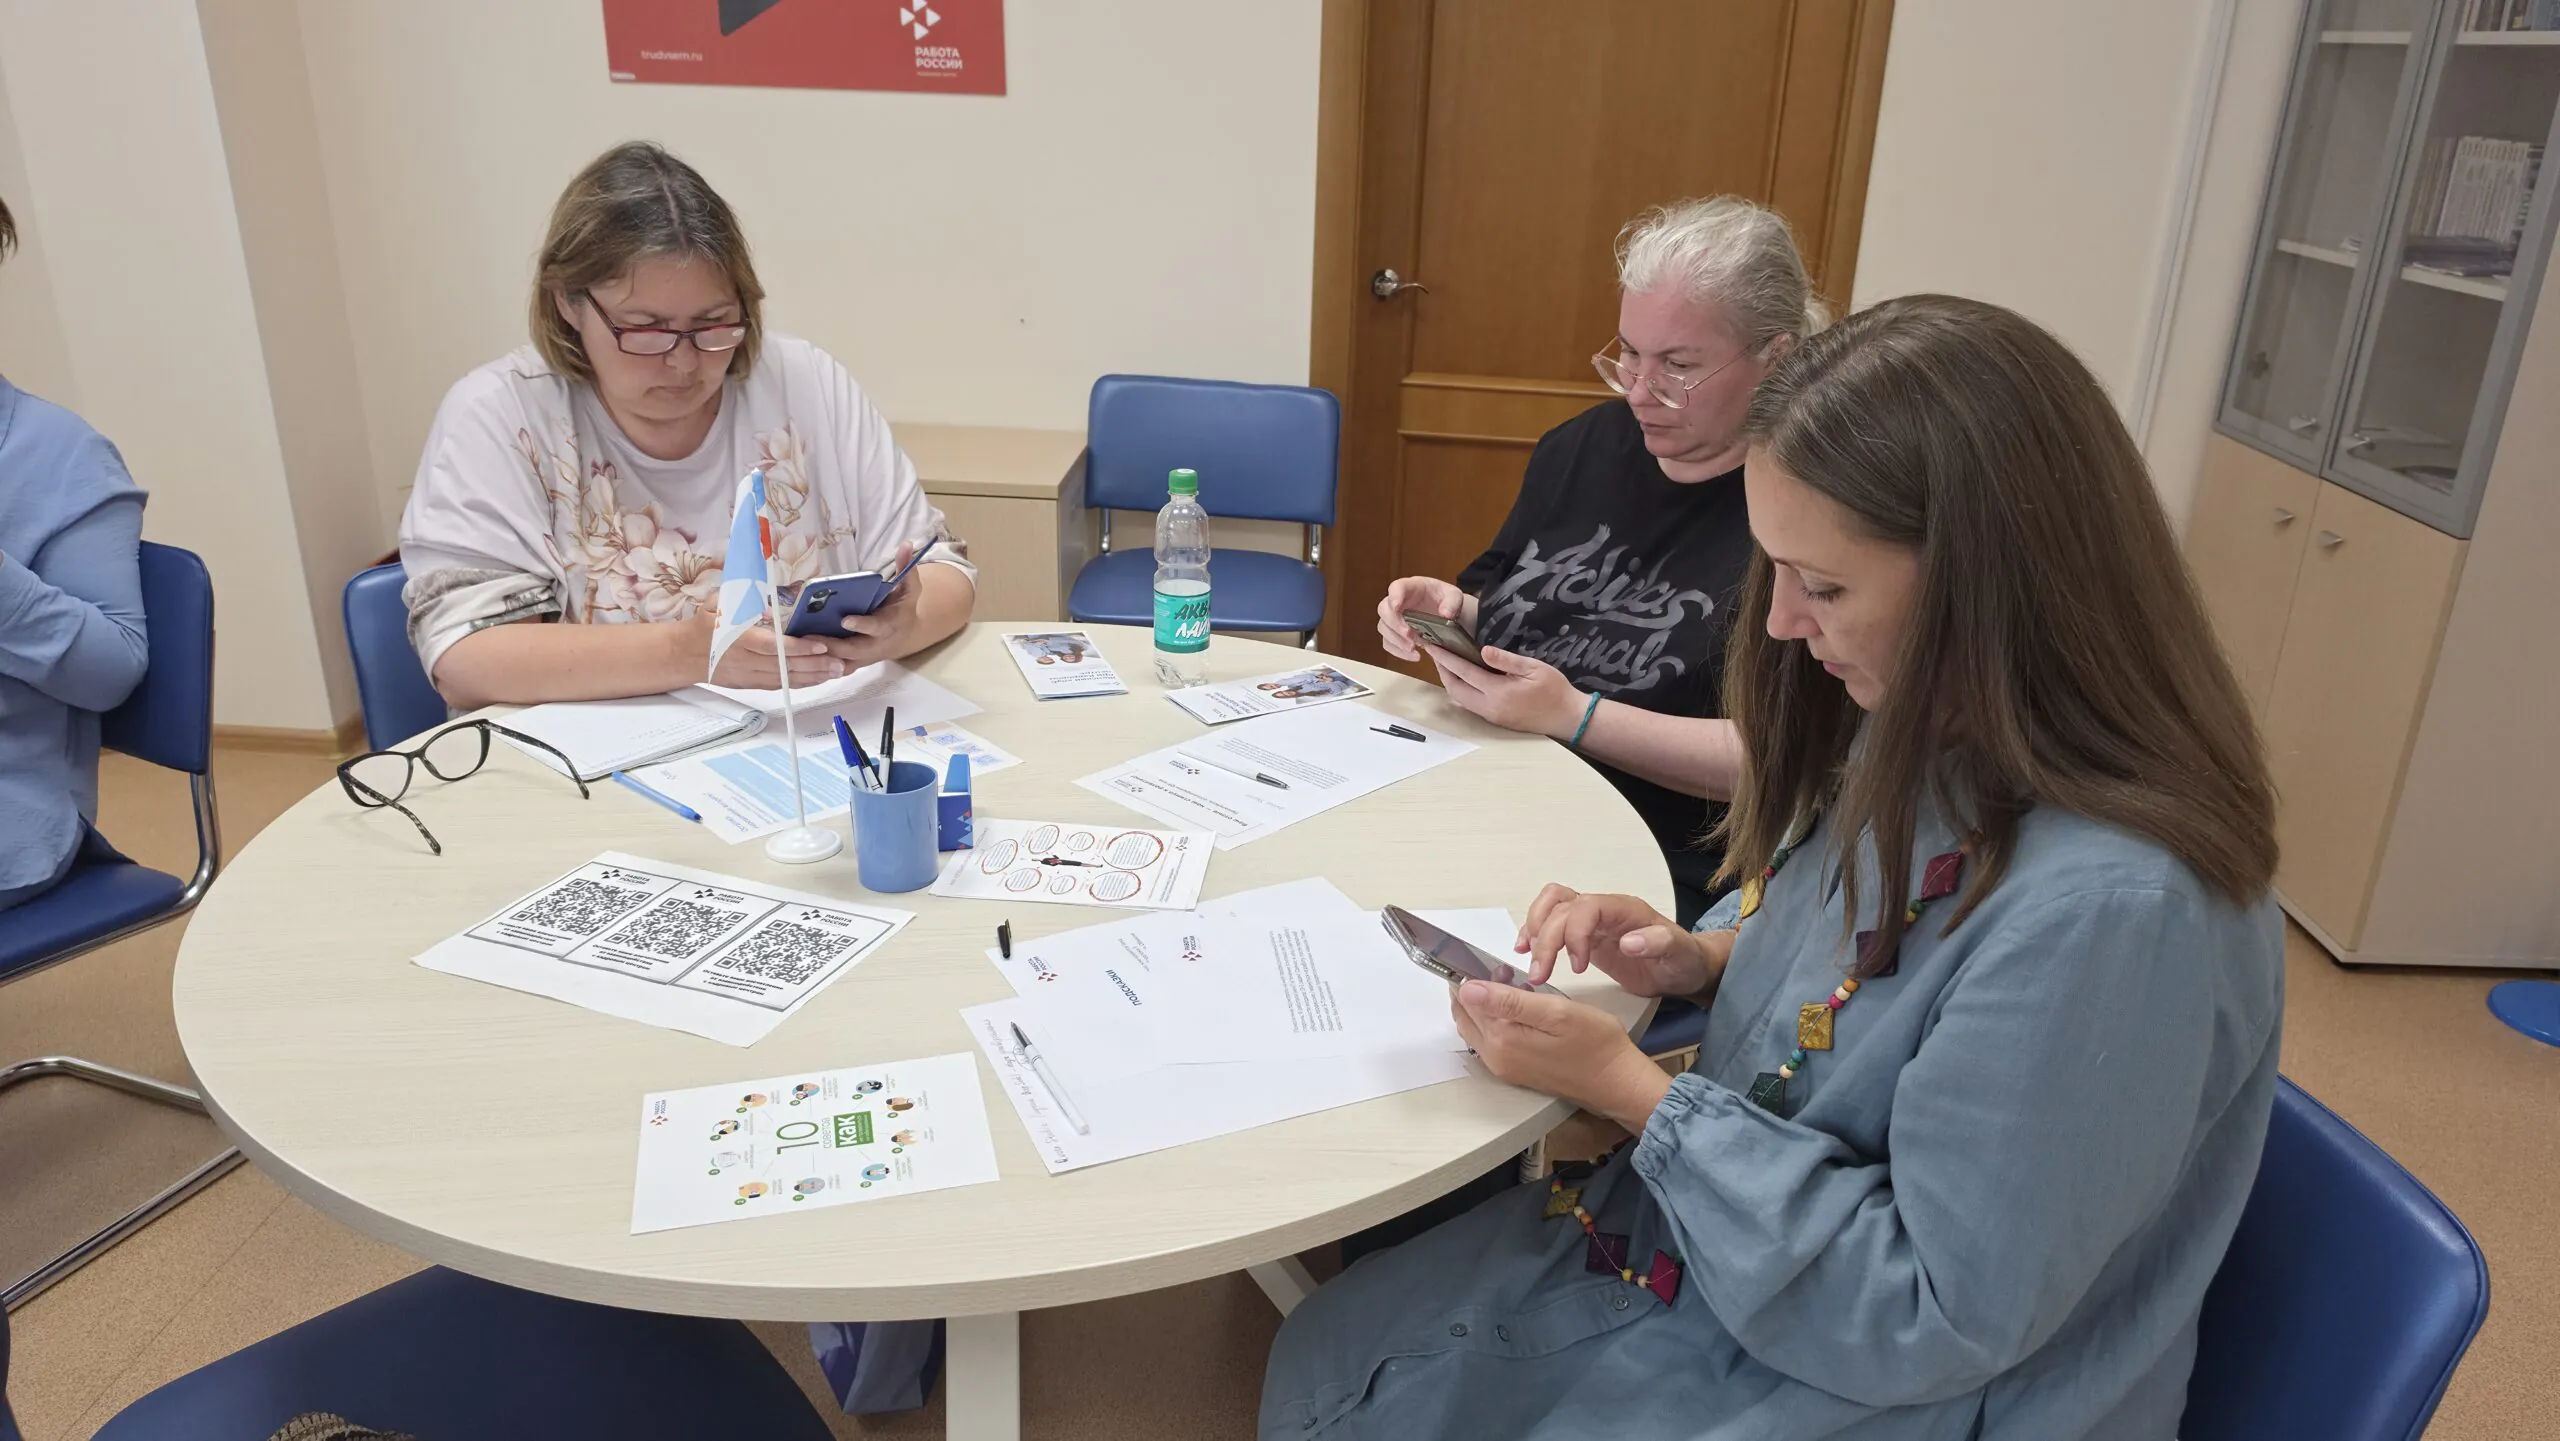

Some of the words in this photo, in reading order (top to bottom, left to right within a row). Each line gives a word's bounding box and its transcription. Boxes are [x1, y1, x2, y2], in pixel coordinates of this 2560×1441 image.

[914, 46, 961, 58] РАБОТА
[915, 58, 963, 70] РОССИИ
[1105, 969, 1143, 1007] ПОДСКАЗКИ
[776, 1121, 819, 1155] 10
[821, 1117, 832, 1149] советов
[838, 1115, 857, 1145] как
